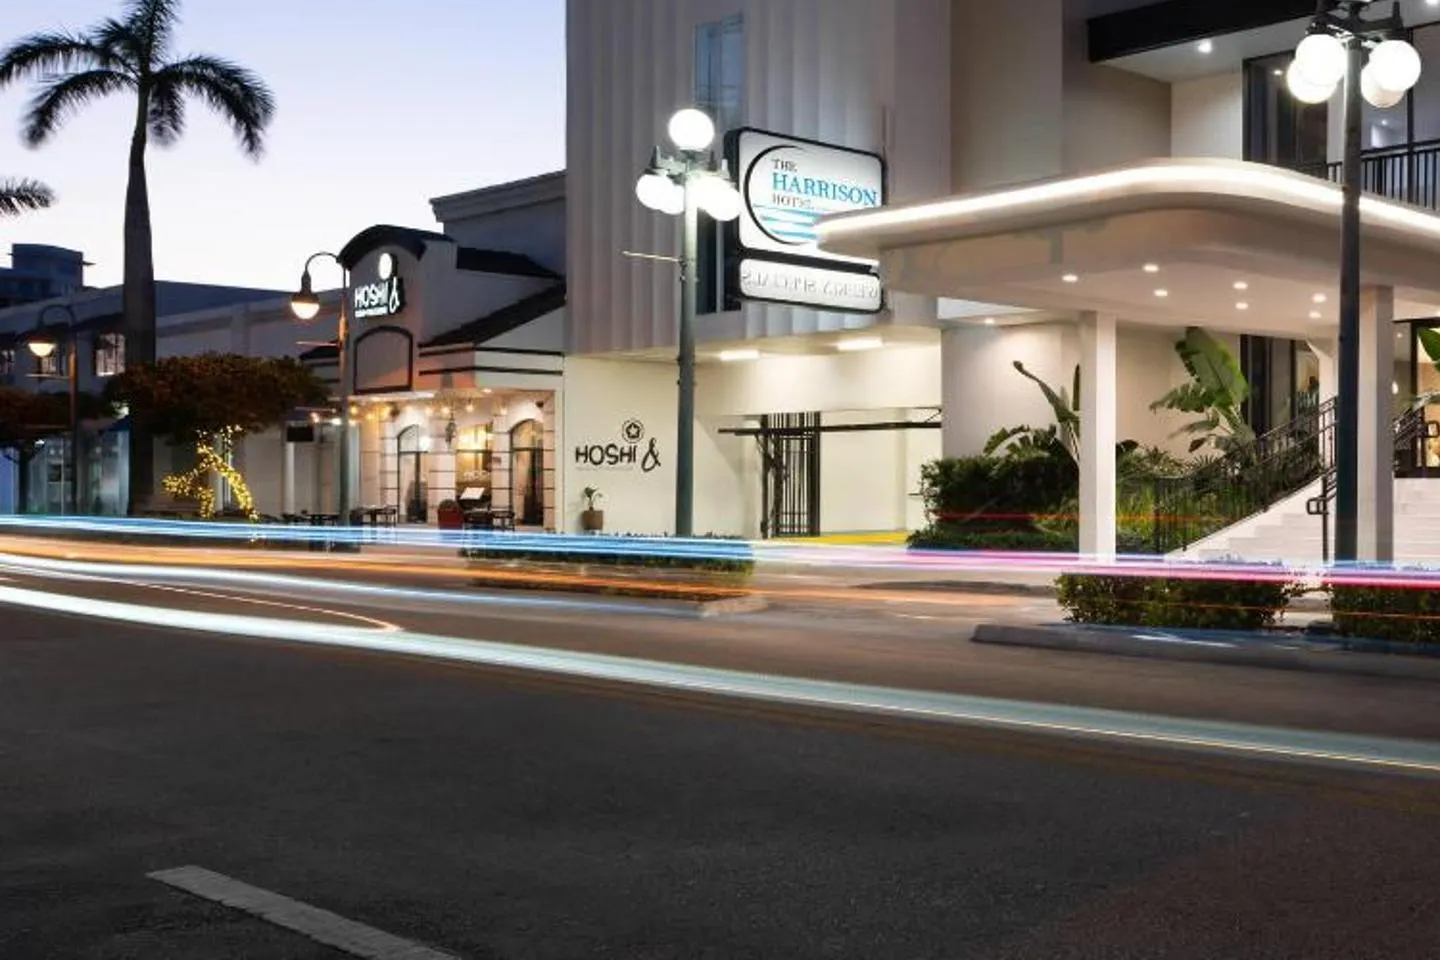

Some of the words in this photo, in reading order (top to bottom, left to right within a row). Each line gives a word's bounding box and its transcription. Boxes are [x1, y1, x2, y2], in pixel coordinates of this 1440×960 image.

[771, 158, 798, 172] THE
[772, 172, 878, 207] HARRISON
[354, 281, 388, 308] HOSHI
[389, 276, 401, 314] &
[575, 443, 637, 466] HOSHI
[641, 437, 662, 472] &
